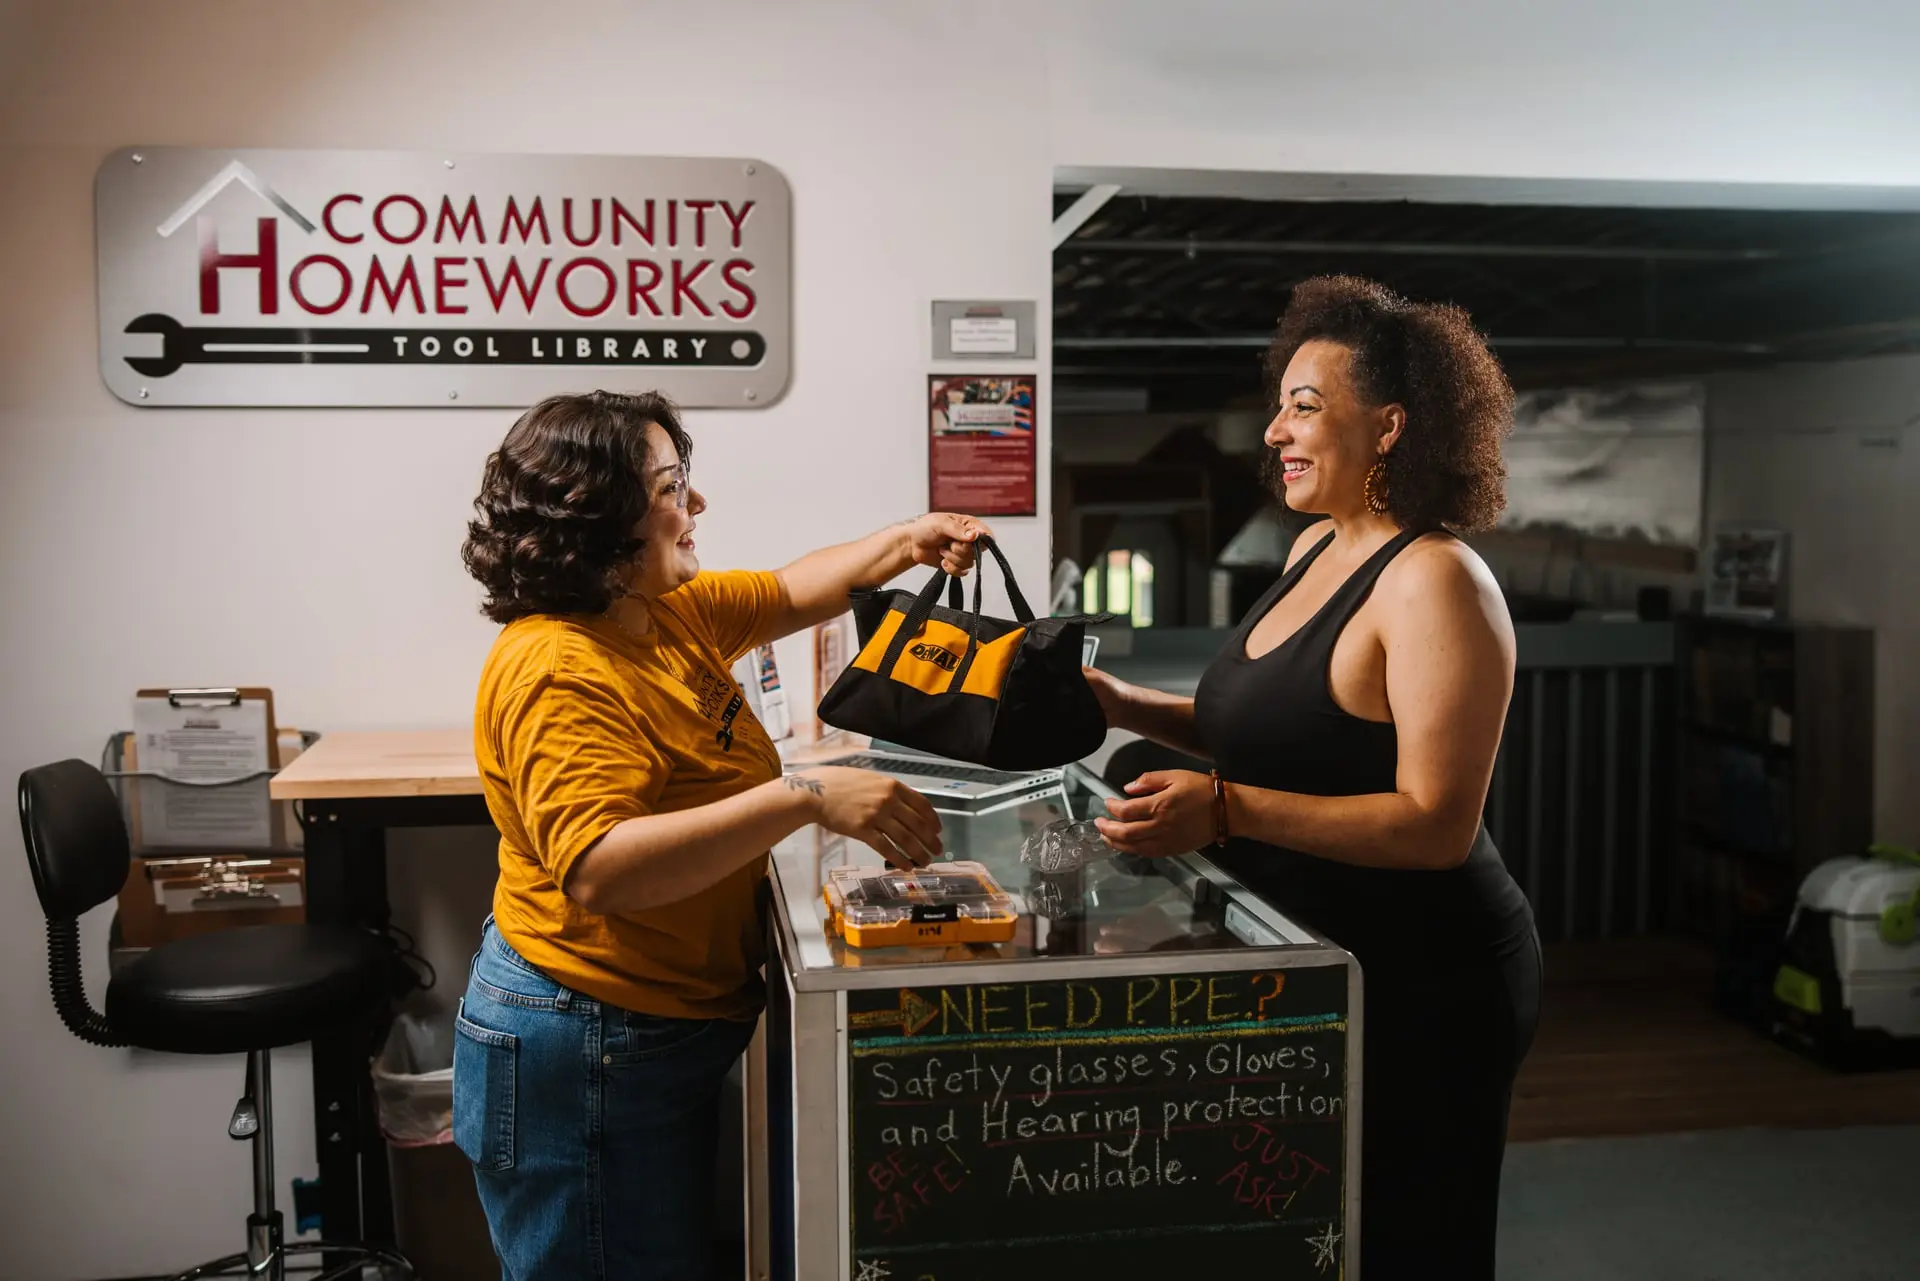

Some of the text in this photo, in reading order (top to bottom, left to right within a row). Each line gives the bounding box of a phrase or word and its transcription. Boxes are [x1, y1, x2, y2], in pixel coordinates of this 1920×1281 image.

[322, 193, 756, 248] COMMUNITY
[198, 216, 757, 319] HOMEWORKS
[393, 336, 707, 359] TOOL LIBRARY
[941, 981, 1102, 1035] NEED
[872, 1043, 1330, 1112] Safety glasses, Gloves,
[881, 1082, 1344, 1157] and Hearing protection
[867, 1149, 919, 1192] BE
[1007, 1137, 1198, 1197] Available.
[1232, 1122, 1332, 1190] JUST
